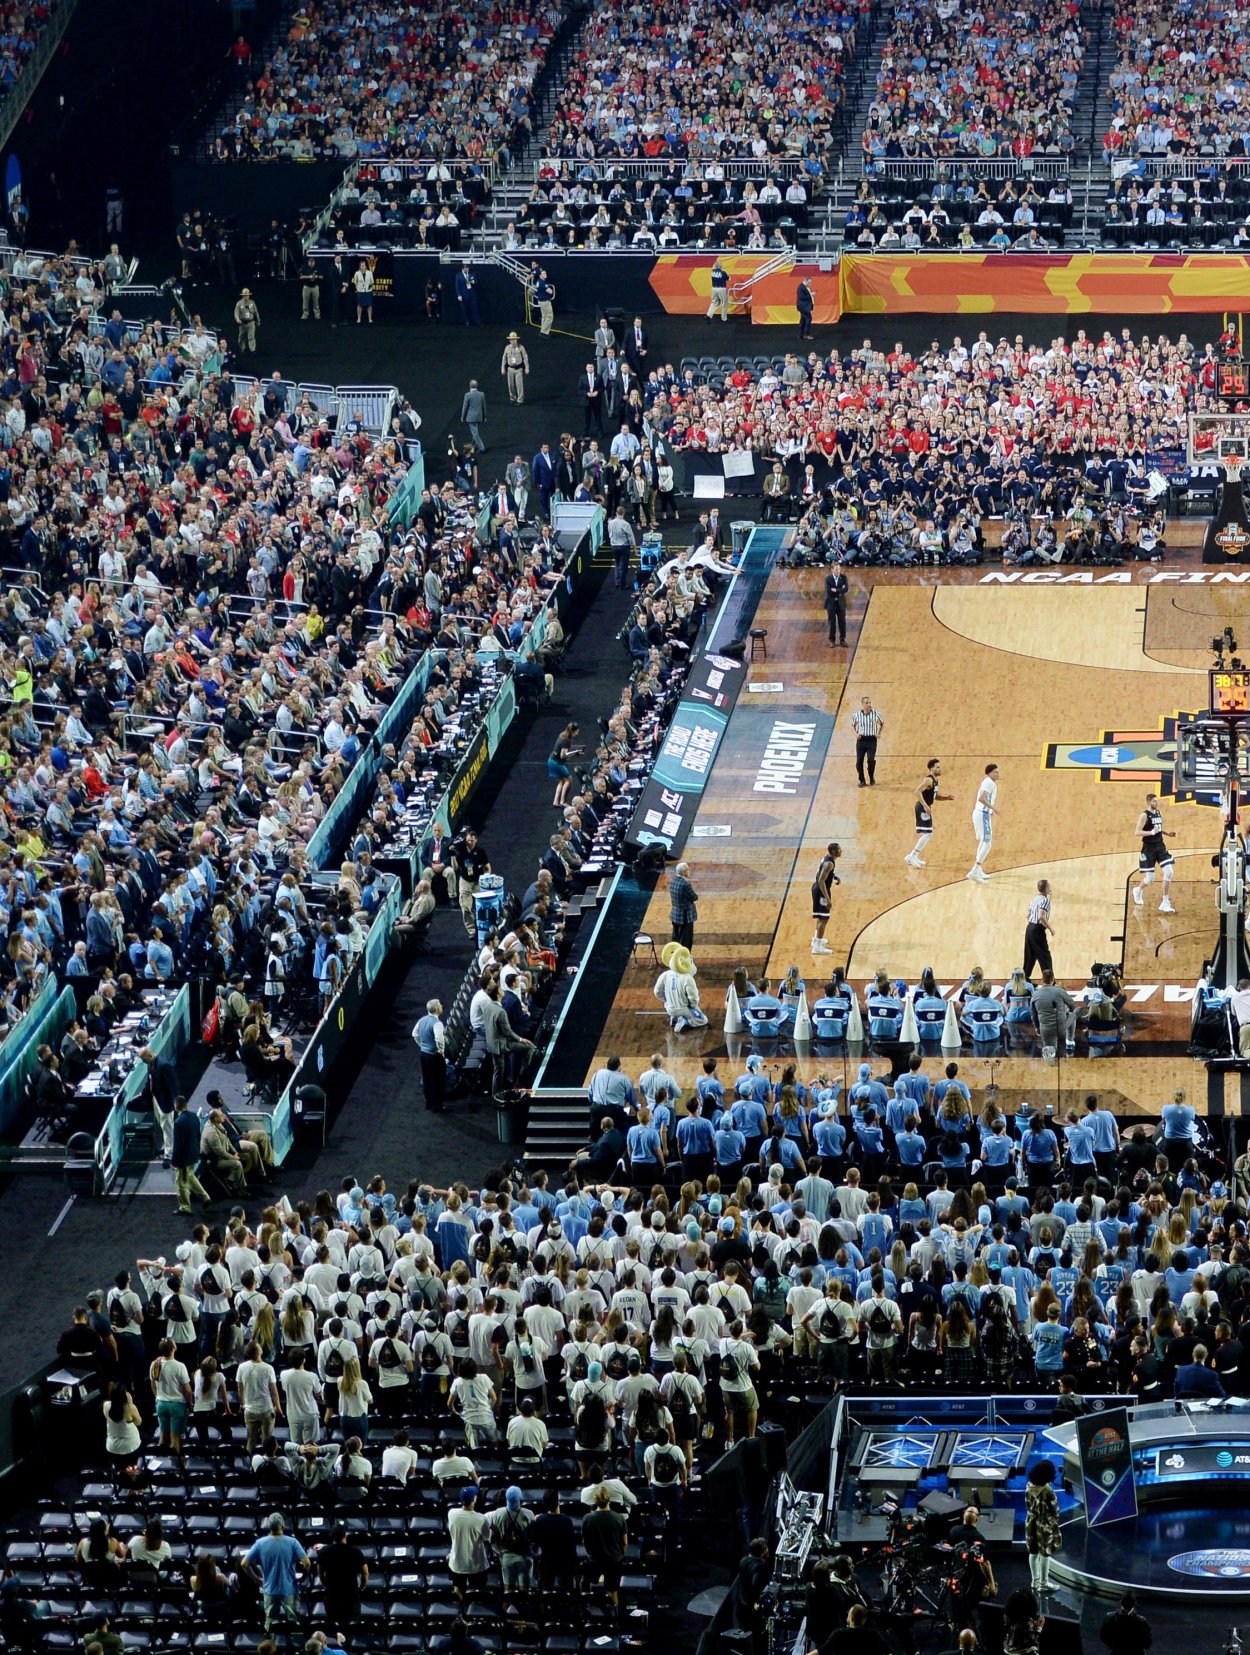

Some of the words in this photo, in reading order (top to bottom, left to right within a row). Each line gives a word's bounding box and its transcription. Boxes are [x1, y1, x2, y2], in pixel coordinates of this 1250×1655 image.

[1222, 375, 1245, 394] 25
[978, 572, 1133, 583] NCAA
[1218, 687, 1248, 711] 25
[689, 725, 718, 753] HERE
[681, 744, 711, 774] ENDS
[753, 720, 817, 794] PHOENIX
[660, 789, 679, 810] ACC
[1055, 1281, 1075, 1296] 23
[1100, 1280, 1118, 1294] 23
[623, 1307, 634, 1321] 17
[1104, 1432, 1117, 1440] AT&T
[1096, 1447, 1108, 1456] THE
[1107, 1443, 1125, 1454] HALF
